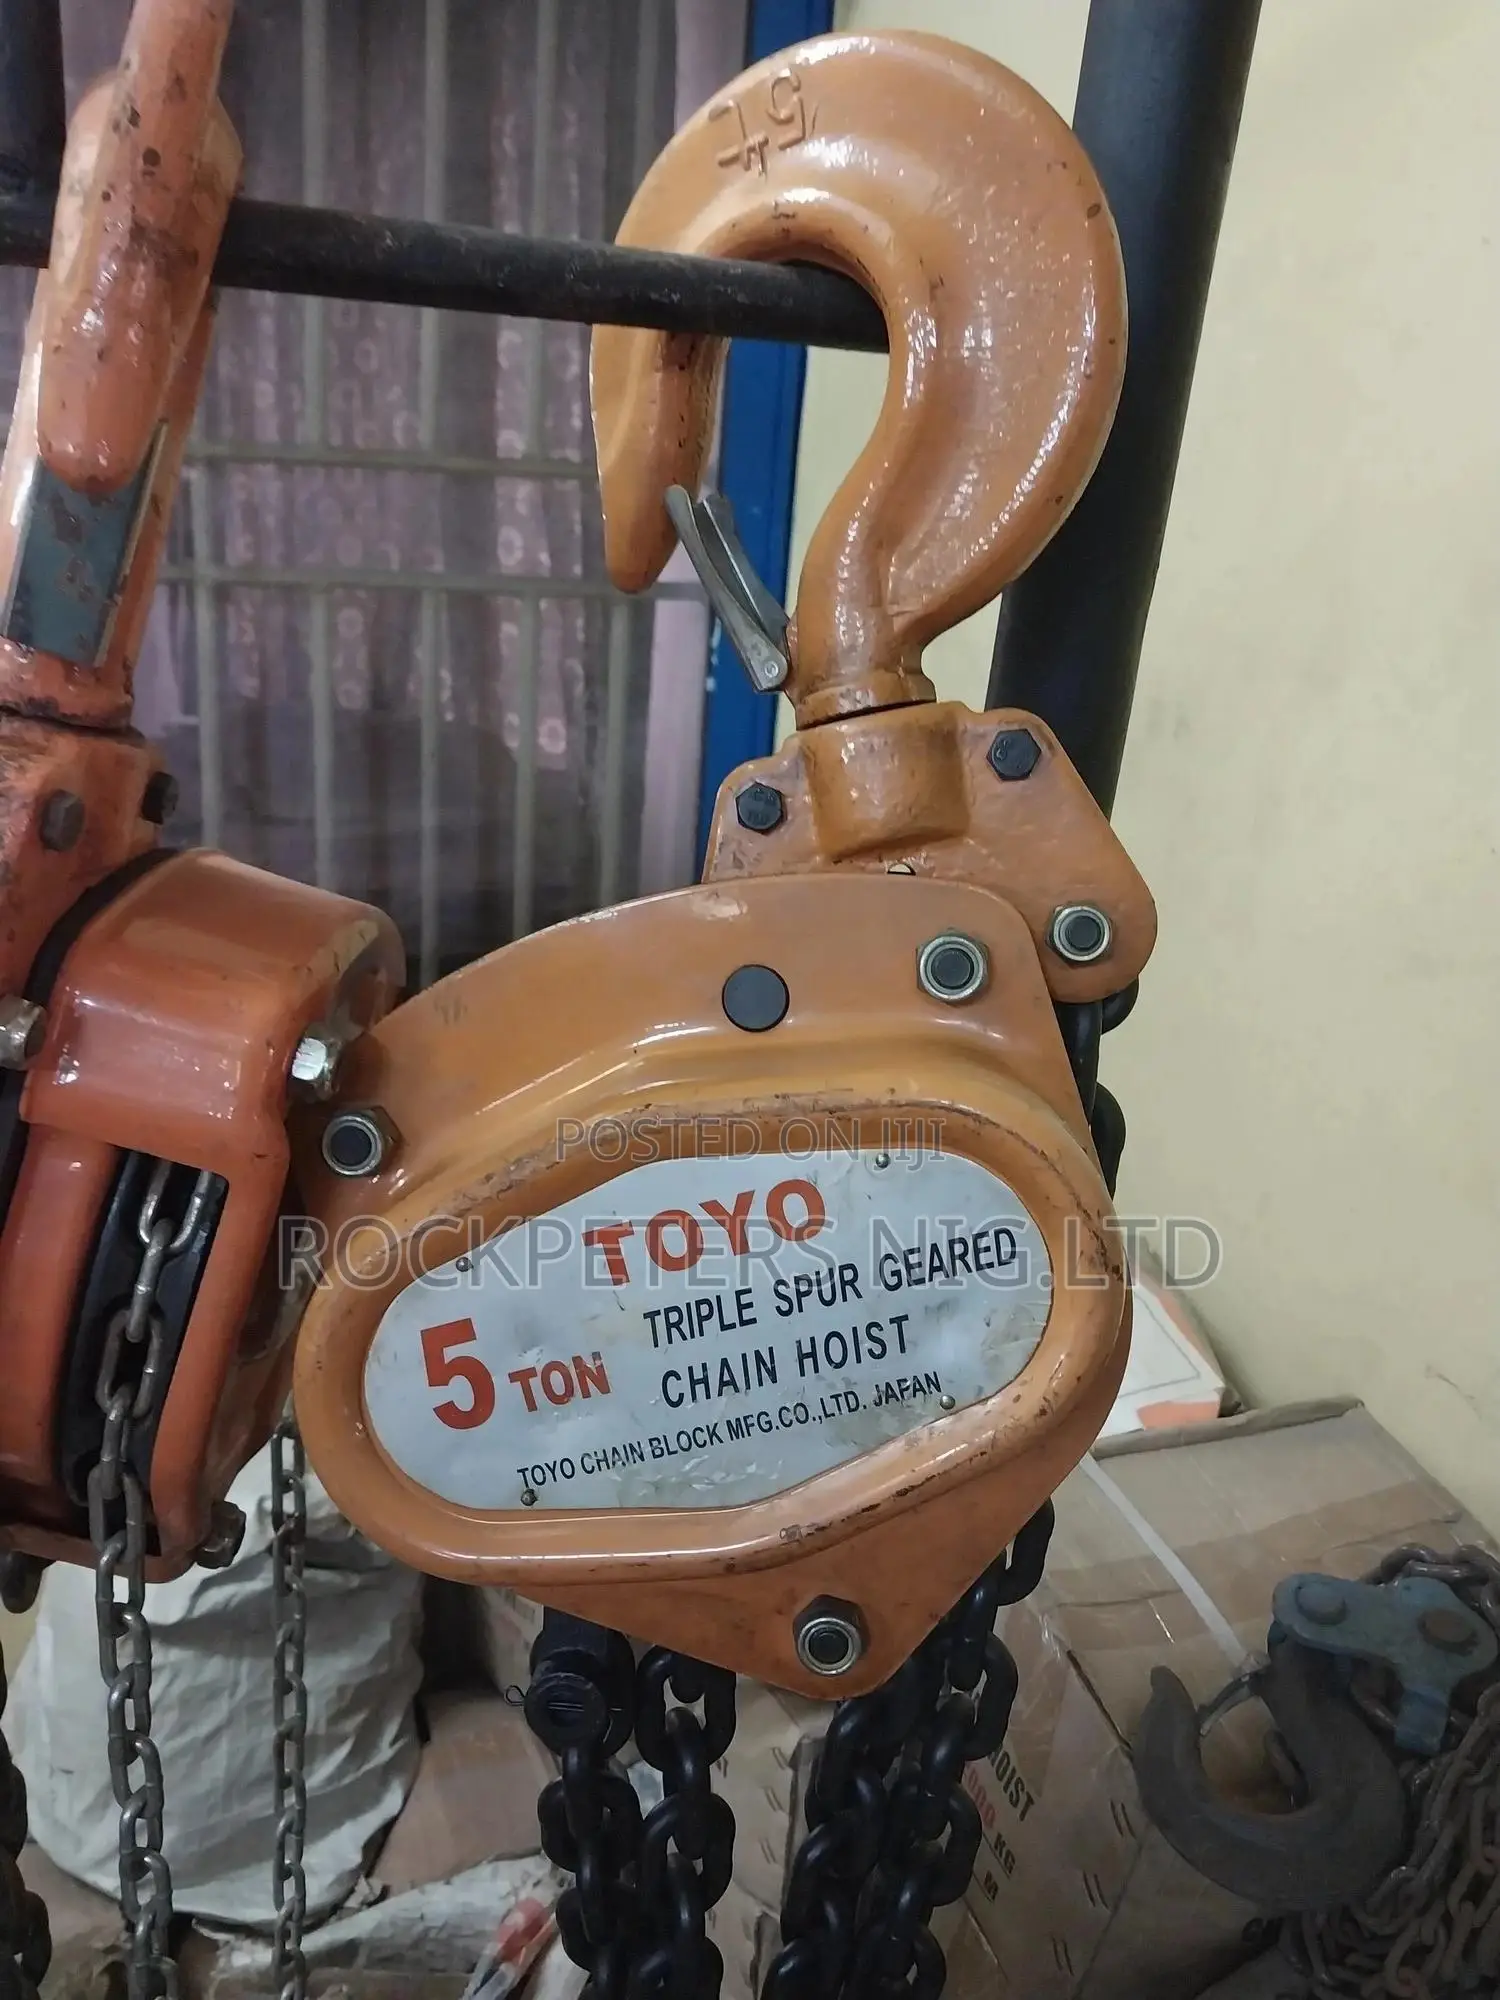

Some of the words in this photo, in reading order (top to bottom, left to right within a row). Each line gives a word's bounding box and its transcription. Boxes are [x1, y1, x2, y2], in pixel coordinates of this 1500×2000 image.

[581, 1178, 826, 1286] TOYO
[643, 1288, 757, 1348] TRIPLE
[773, 1262, 863, 1318] SPUR
[879, 1227, 1017, 1293] GEARED
[420, 1317, 496, 1430] 5
[508, 1351, 612, 1412] TON
[661, 1346, 777, 1409] CHAIN
[795, 1314, 910, 1378] HOIST
[516, 1457, 576, 1488] TOYO
[580, 1441, 645, 1475] CHAIN
[648, 1422, 724, 1460] BLOCK
